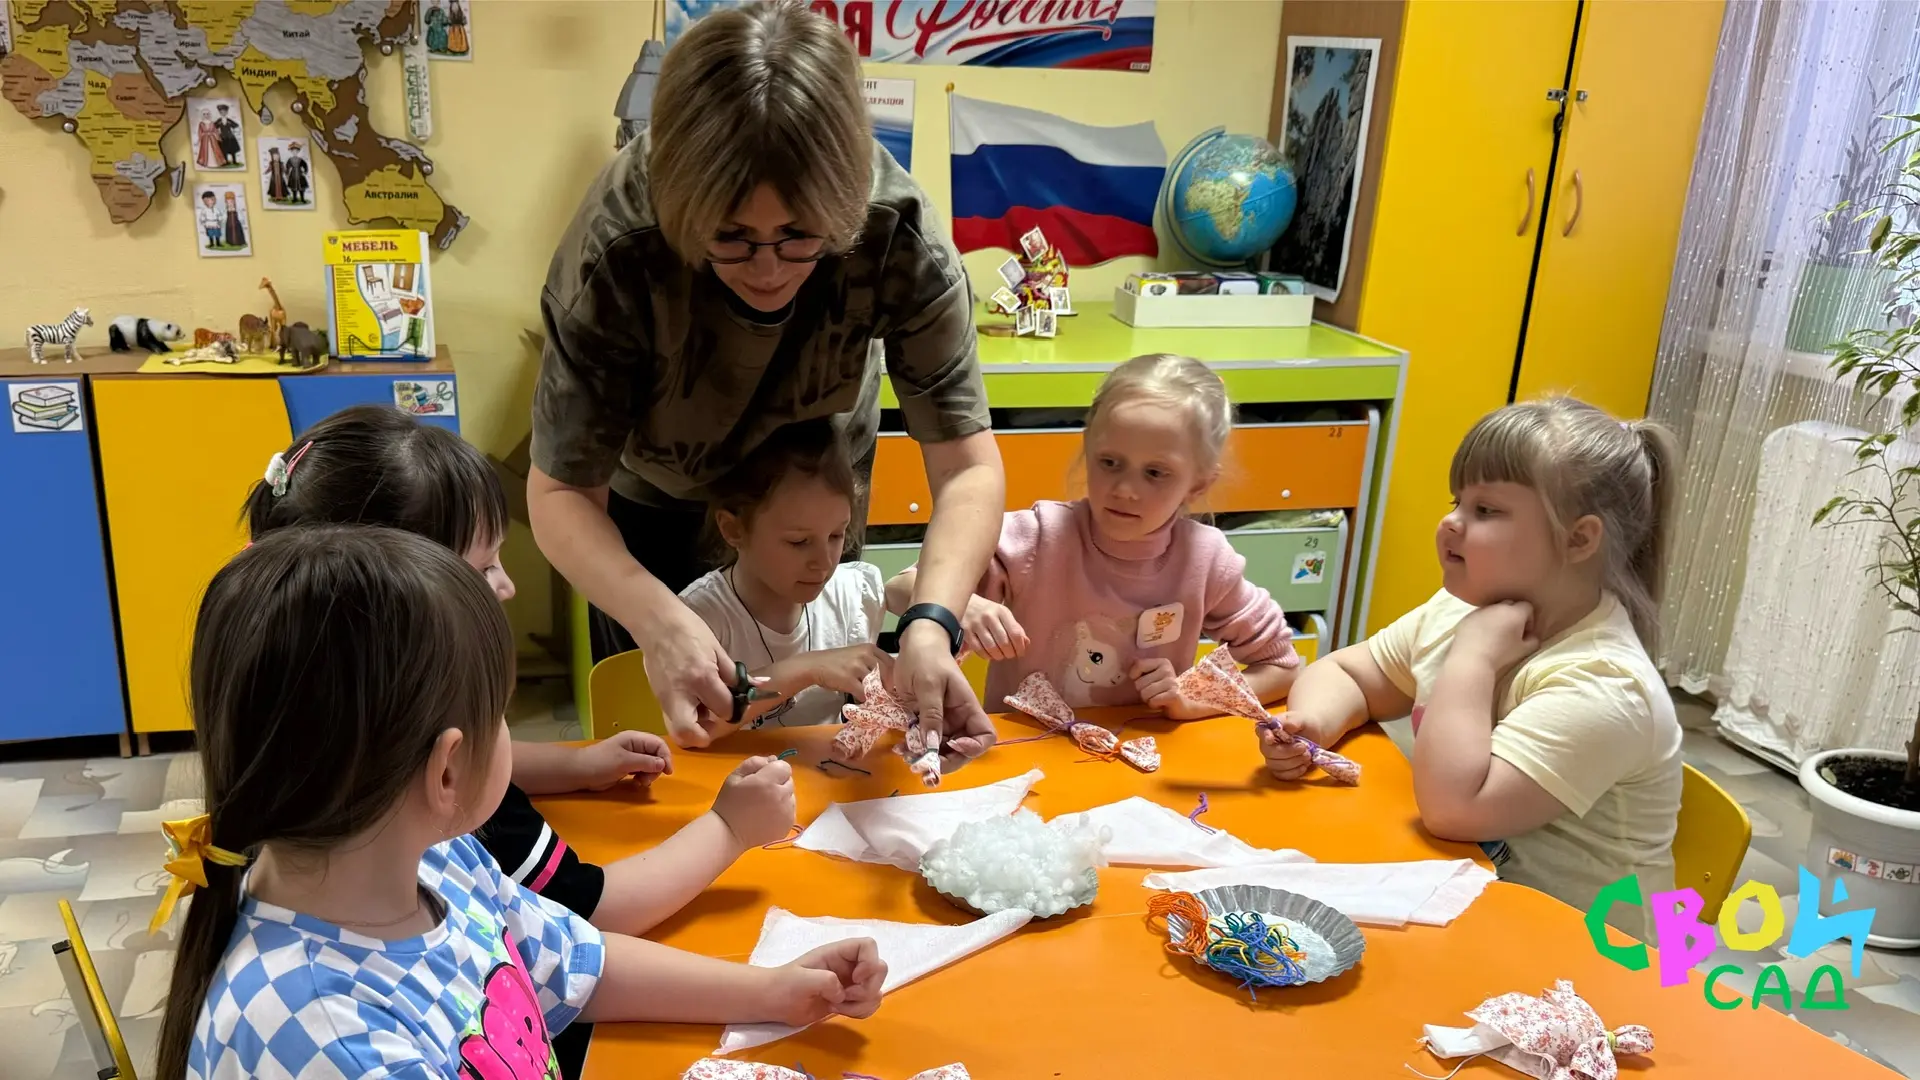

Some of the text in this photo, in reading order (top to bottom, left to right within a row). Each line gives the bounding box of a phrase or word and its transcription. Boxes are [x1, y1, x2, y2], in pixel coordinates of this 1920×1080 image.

[282, 30, 310, 38] Китай
[241, 66, 278, 78] Индия
[88, 80, 107, 89] Чад
[364, 189, 419, 200] Австралия
[342, 240, 399, 252] МЕБЕЛЬ
[1328, 427, 1344, 438] 28
[1304, 536, 1319, 549] 29
